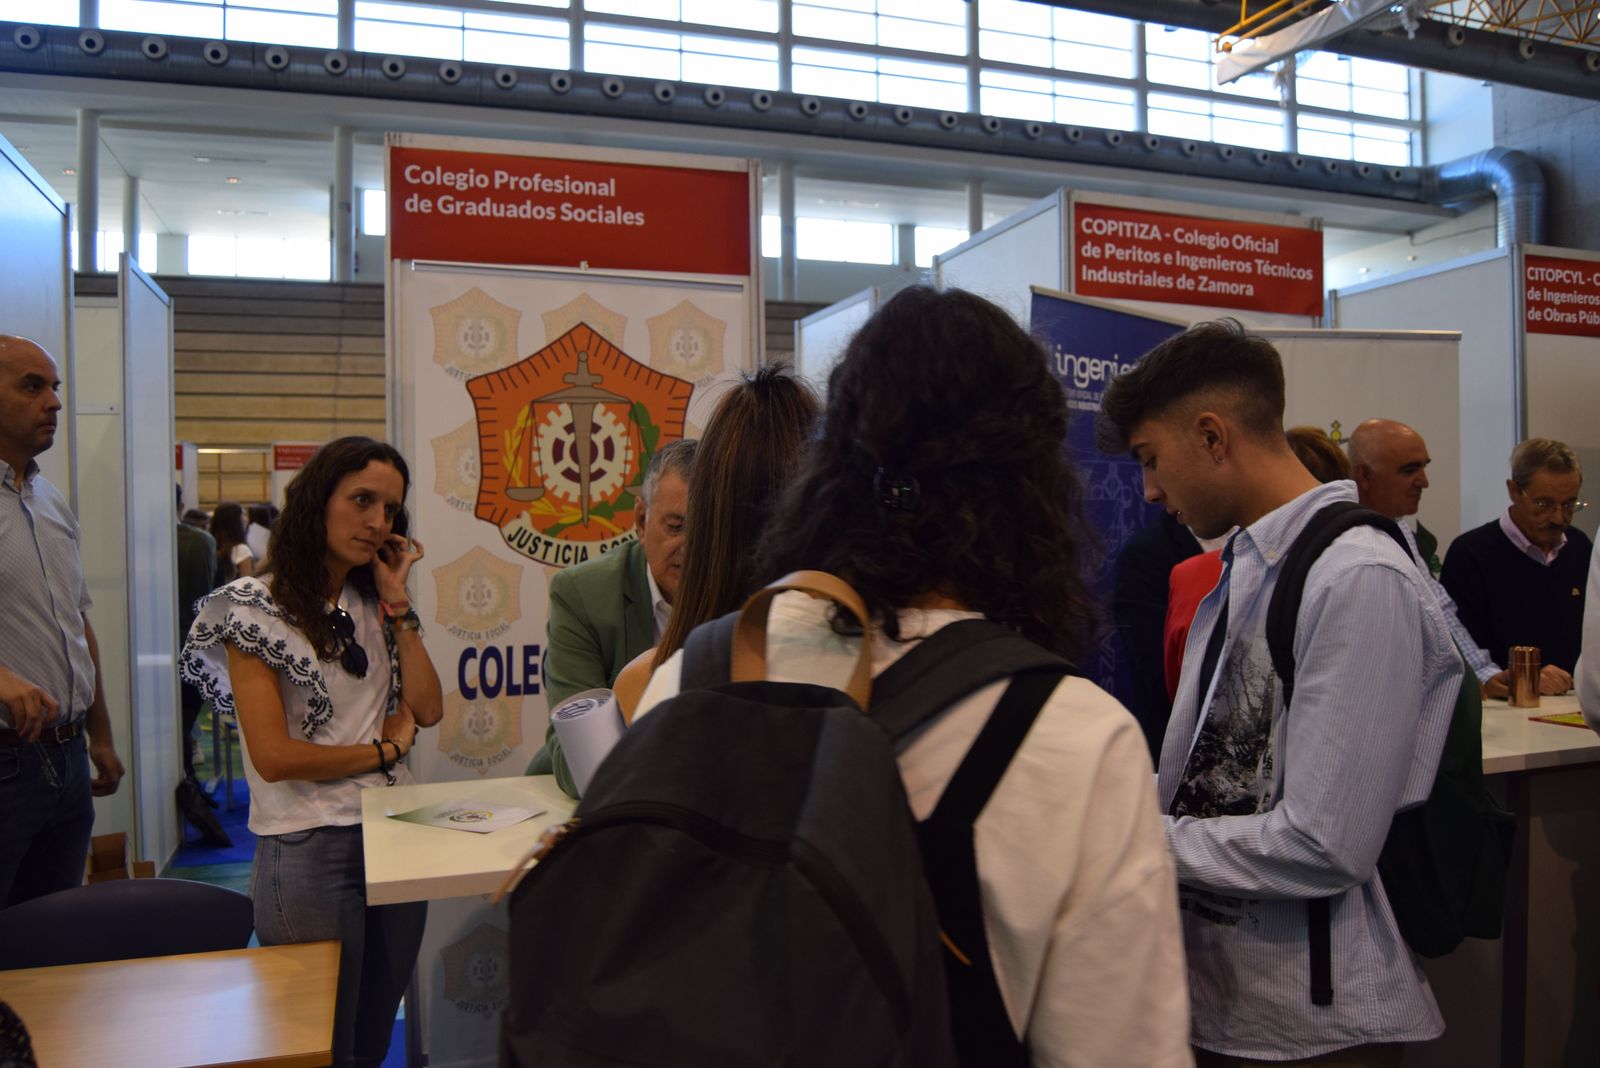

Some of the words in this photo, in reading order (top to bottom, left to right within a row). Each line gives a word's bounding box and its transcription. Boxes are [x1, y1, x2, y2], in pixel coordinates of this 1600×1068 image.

[404, 164, 489, 190] Colegio
[494, 170, 615, 197] Profesional
[404, 194, 432, 214] de
[437, 195, 556, 221] Graduados
[560, 203, 645, 226] Sociales
[1081, 217, 1162, 241] COPITIZA
[1173, 227, 1229, 250] Colegio
[1231, 234, 1279, 255] Oficial
[1081, 241, 1101, 258] de
[1104, 243, 1160, 265] Peritos
[1163, 253, 1173, 265] e
[1175, 251, 1252, 273] Ingenieros
[1254, 259, 1314, 281] Técnicos
[1526, 266, 1585, 285] CITOPCYL
[1081, 265, 1173, 288] Industriales
[1176, 274, 1195, 290] de
[1198, 275, 1254, 297] Zamora
[1527, 286, 1541, 301] de
[1543, 287, 1600, 305] Ingenieros
[1527, 306, 1542, 320] de
[1543, 307, 1577, 323] Obras
[507, 526, 589, 566] JUSTICIA
[458, 644, 548, 700] COLE
